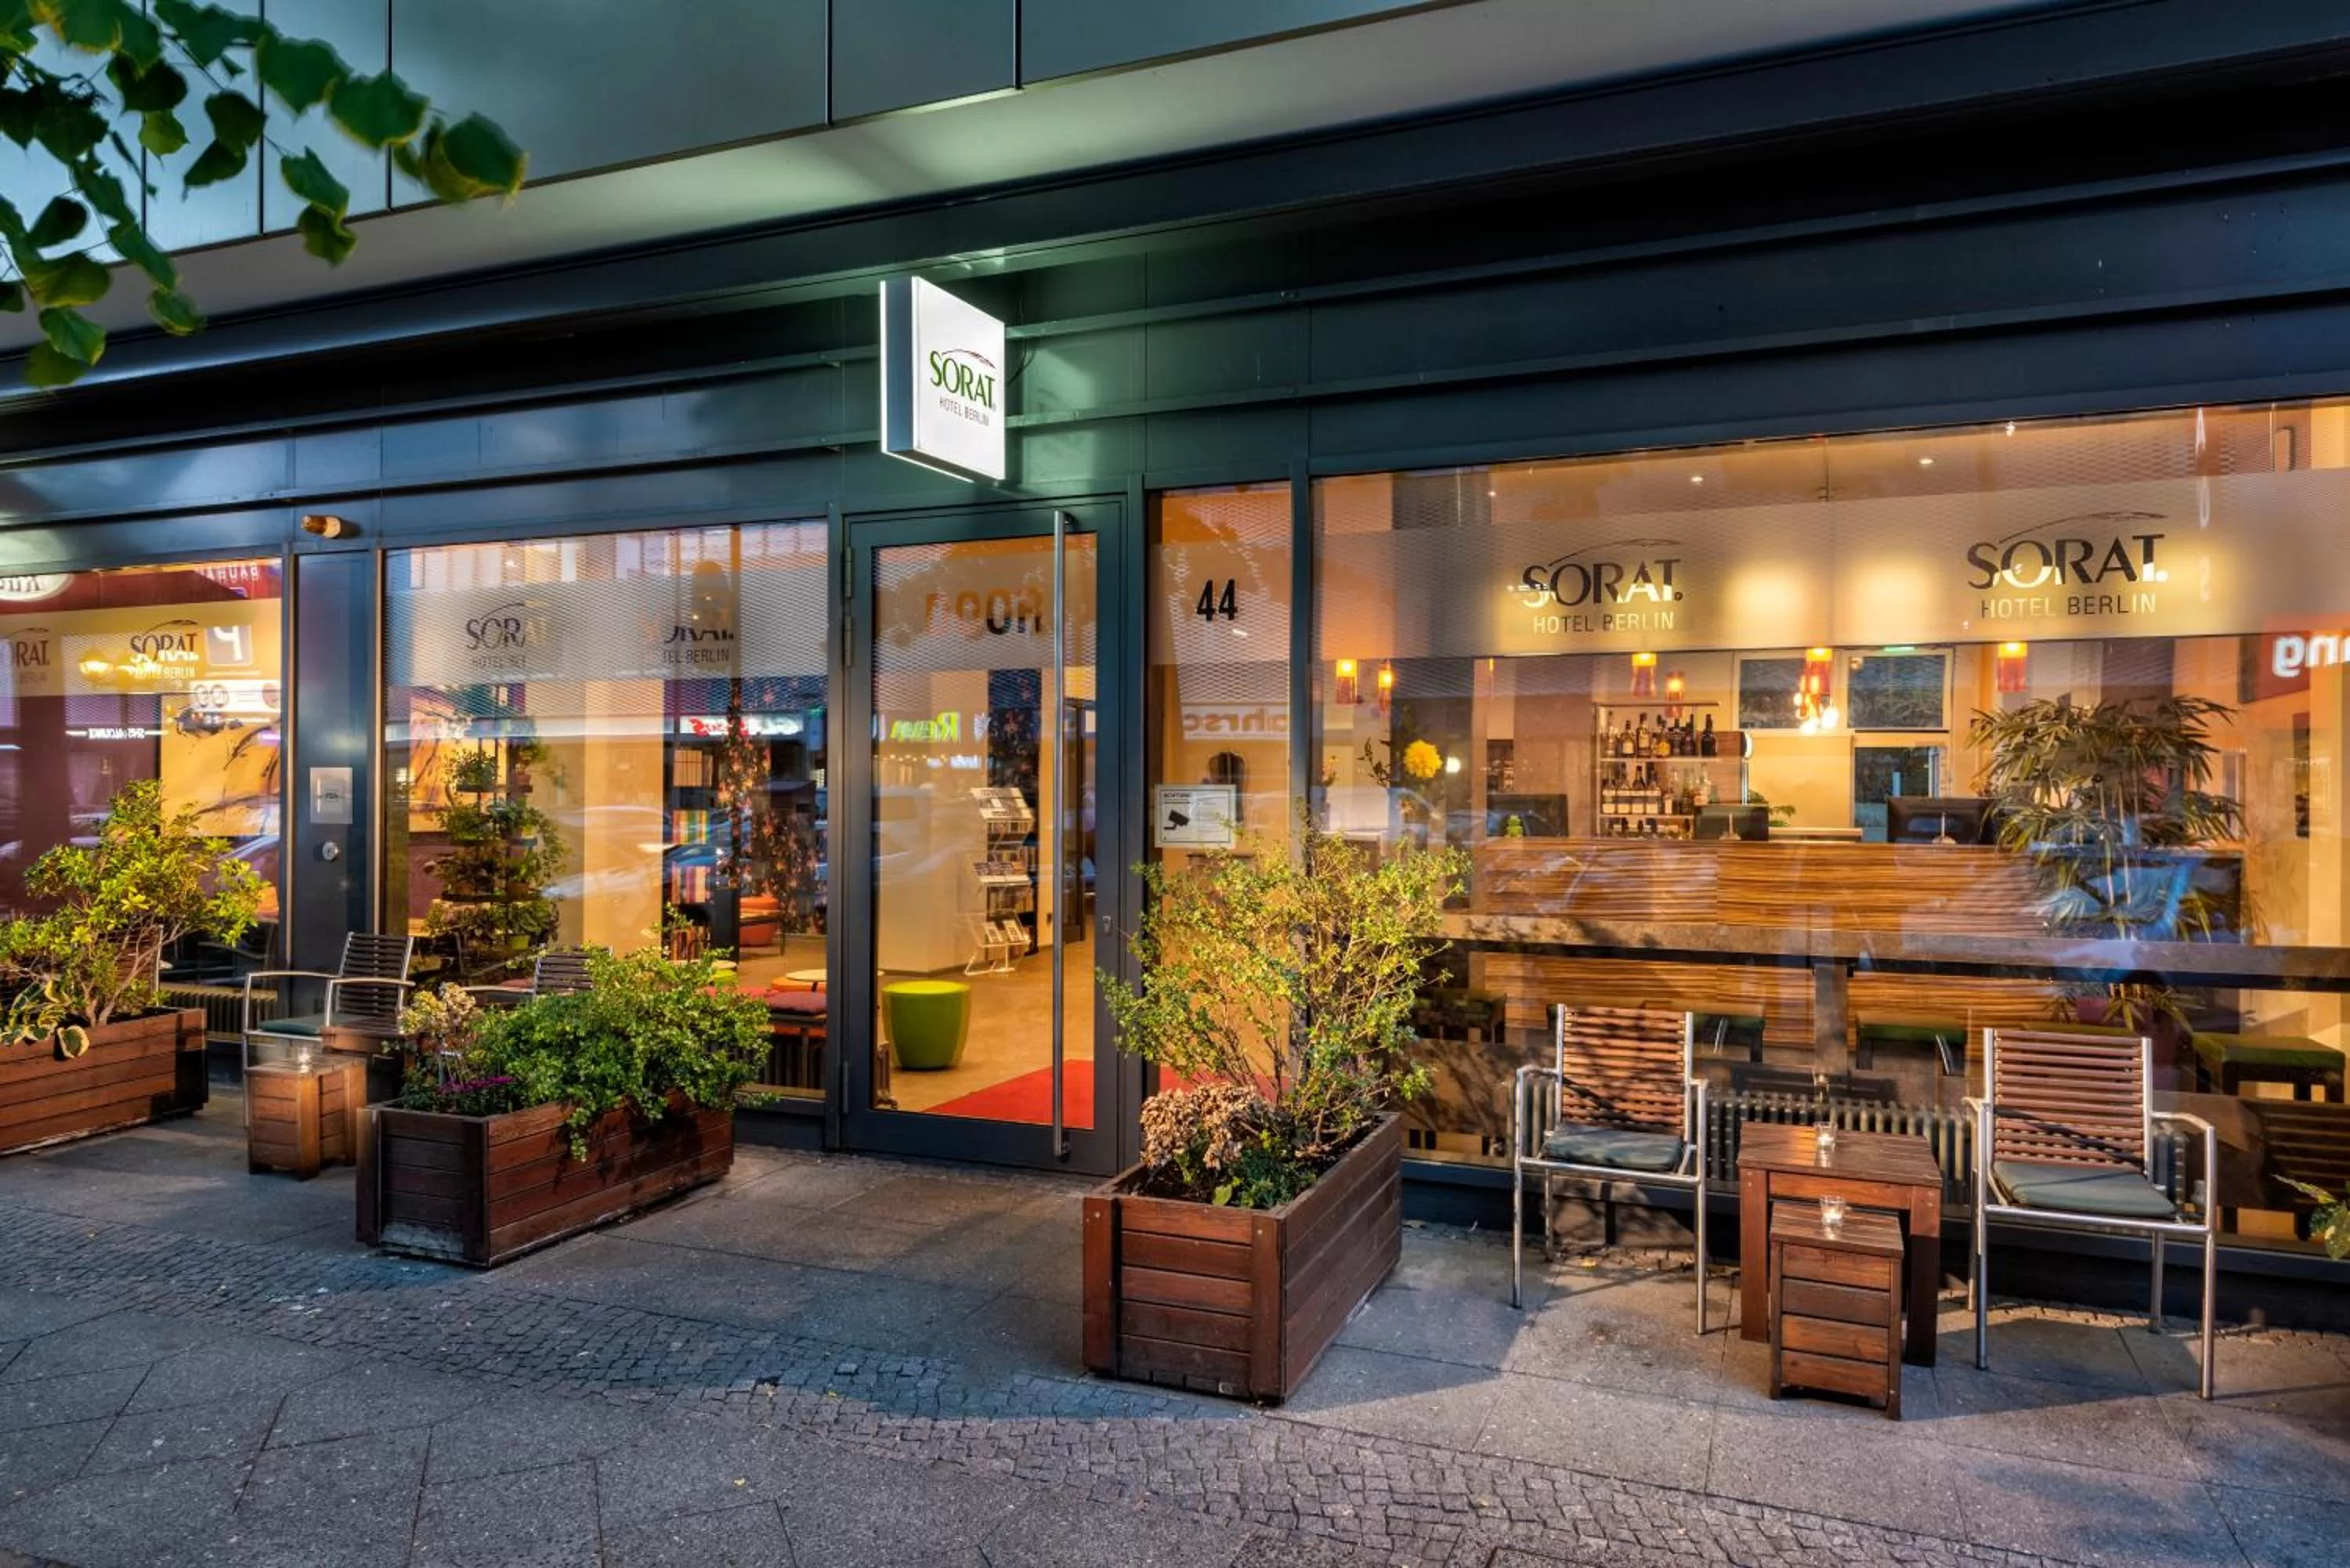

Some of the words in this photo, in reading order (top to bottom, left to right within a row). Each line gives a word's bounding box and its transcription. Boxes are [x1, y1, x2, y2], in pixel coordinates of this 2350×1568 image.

[930, 350, 996, 410] SORAT
[939, 396, 963, 417] HOTEL
[964, 406, 989, 427] BERLIN
[1522, 559, 1683, 608] SORAT
[1967, 534, 2169, 590] SORAT
[1196, 578, 1238, 621] 44
[1981, 598, 2056, 619] HOTEL
[2067, 593, 2157, 615] BERLIN
[1532, 615, 1594, 634] HOTEL
[1603, 611, 1675, 633] BERLIN
